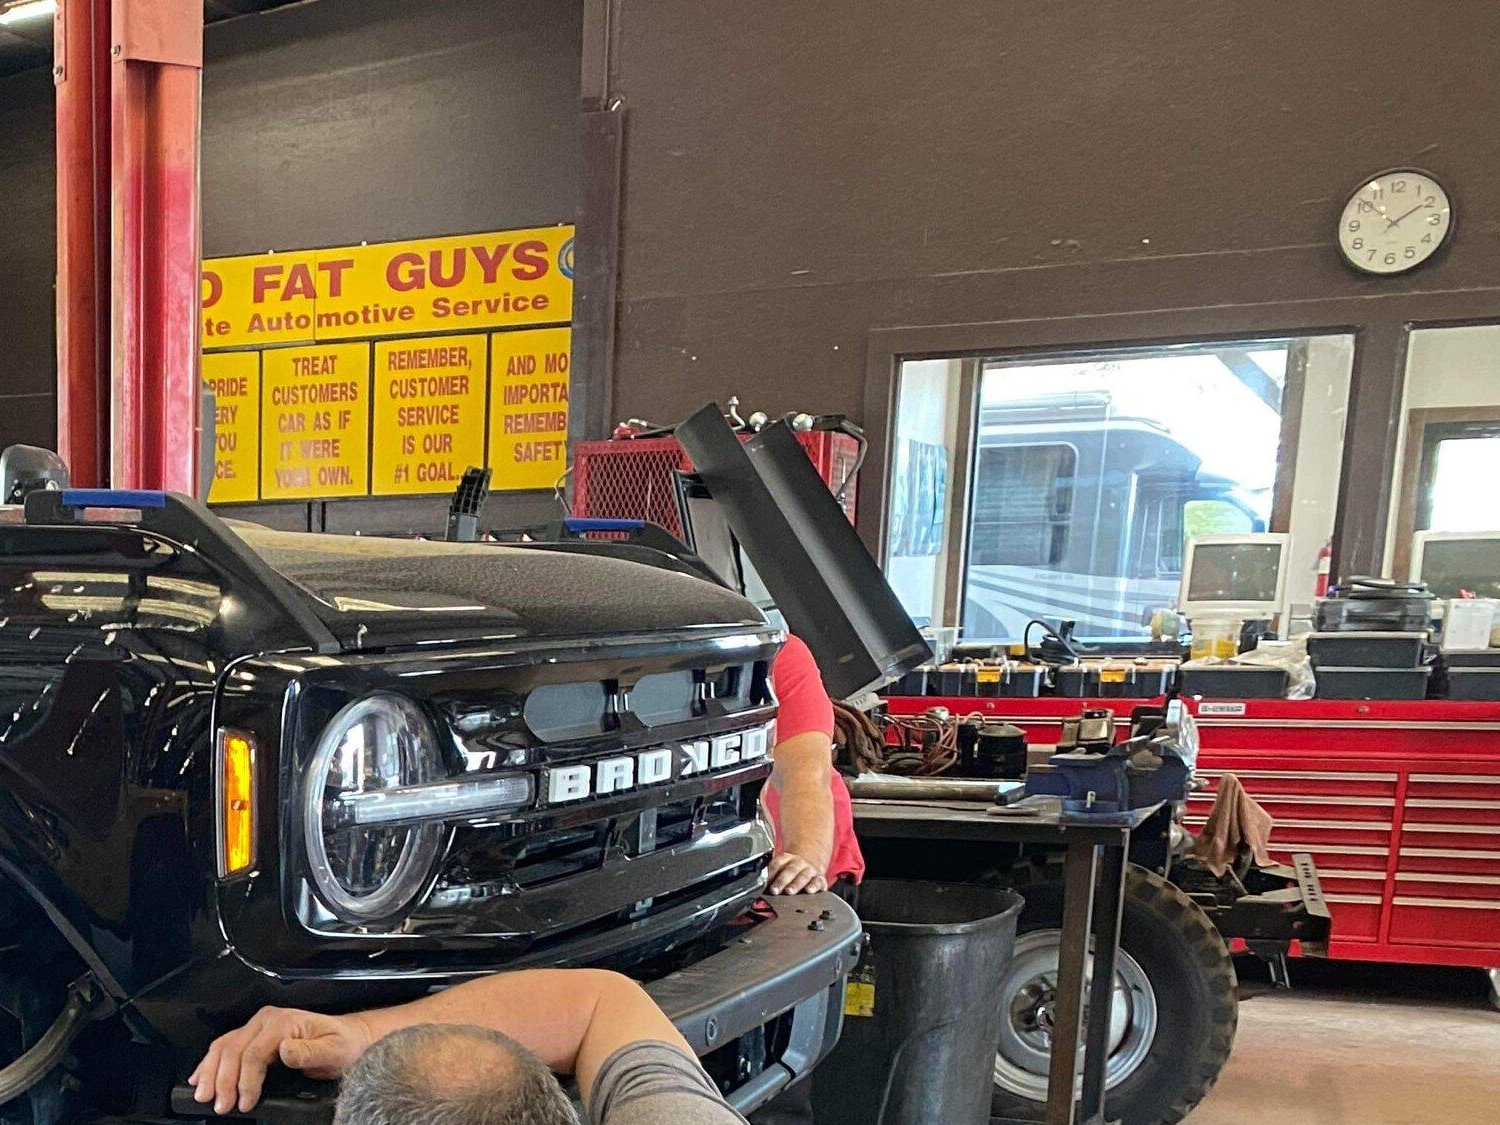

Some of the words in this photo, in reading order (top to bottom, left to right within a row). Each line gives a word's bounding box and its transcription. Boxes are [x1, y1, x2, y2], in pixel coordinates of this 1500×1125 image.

[1373, 188, 1384, 200] 11
[1390, 180, 1406, 193] 12
[1415, 184, 1422, 196] 1
[1357, 201, 1373, 214] 10
[1424, 196, 1435, 208] 2
[1348, 220, 1360, 232] 9
[1428, 213, 1441, 226] 3
[1352, 237, 1363, 250] 8
[1420, 233, 1432, 243] 4
[1367, 249, 1377, 261] 7
[1384, 252, 1396, 265] 6
[1404, 246, 1415, 259] 5
[253, 259, 355, 303] FAT
[386, 240, 549, 292] GUYS
[247, 303, 415, 333] Automotive
[432, 292, 549, 318] Service
[292, 354, 338, 376] TREAT
[388, 346, 472, 371] REMEMBER,
[506, 354, 536, 376] AND
[544, 352, 568, 374] MO
[272, 381, 358, 406] CUSTOMERS
[389, 375, 469, 400] CUSTOMER
[503, 382, 569, 406] IMPORTA
[215, 405, 238, 425] ERY
[278, 412, 305, 434] CAR
[312, 411, 331, 431] AS
[338, 410, 352, 430] IF
[397, 404, 459, 427] SERVICE
[504, 411, 567, 435] REMEMB
[215, 432, 237, 452] OU
[280, 441, 293, 461] IT
[300, 438, 340, 459] WERE
[402, 435, 415, 455] IS
[423, 433, 452, 454] OUR
[513, 440, 566, 463] SAFET
[275, 467, 311, 489] YOUR
[318, 466, 353, 487] OWN.
[394, 463, 410, 485] #1
